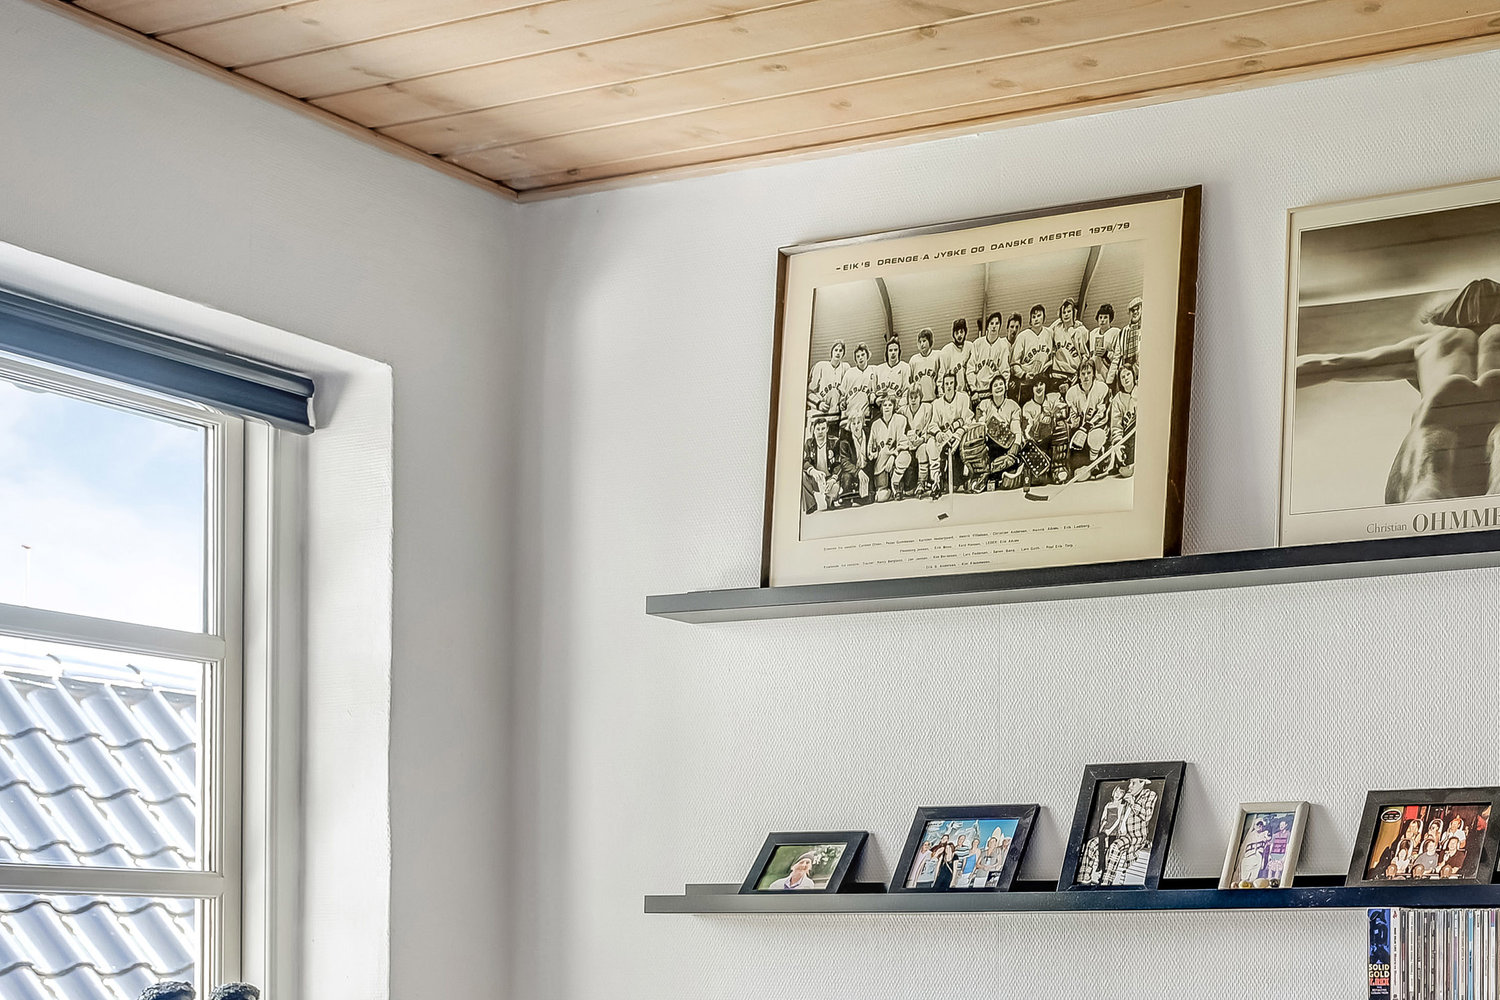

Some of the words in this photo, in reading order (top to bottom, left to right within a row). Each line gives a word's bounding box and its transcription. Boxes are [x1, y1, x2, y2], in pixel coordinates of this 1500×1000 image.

[934, 248, 967, 259] JYSKE
[990, 237, 1034, 251] DANSKE
[1039, 229, 1082, 243] MESTRE
[1366, 521, 1408, 534] Christian
[1368, 963, 1390, 971] SOLID
[1368, 970, 1390, 978] GOLD
